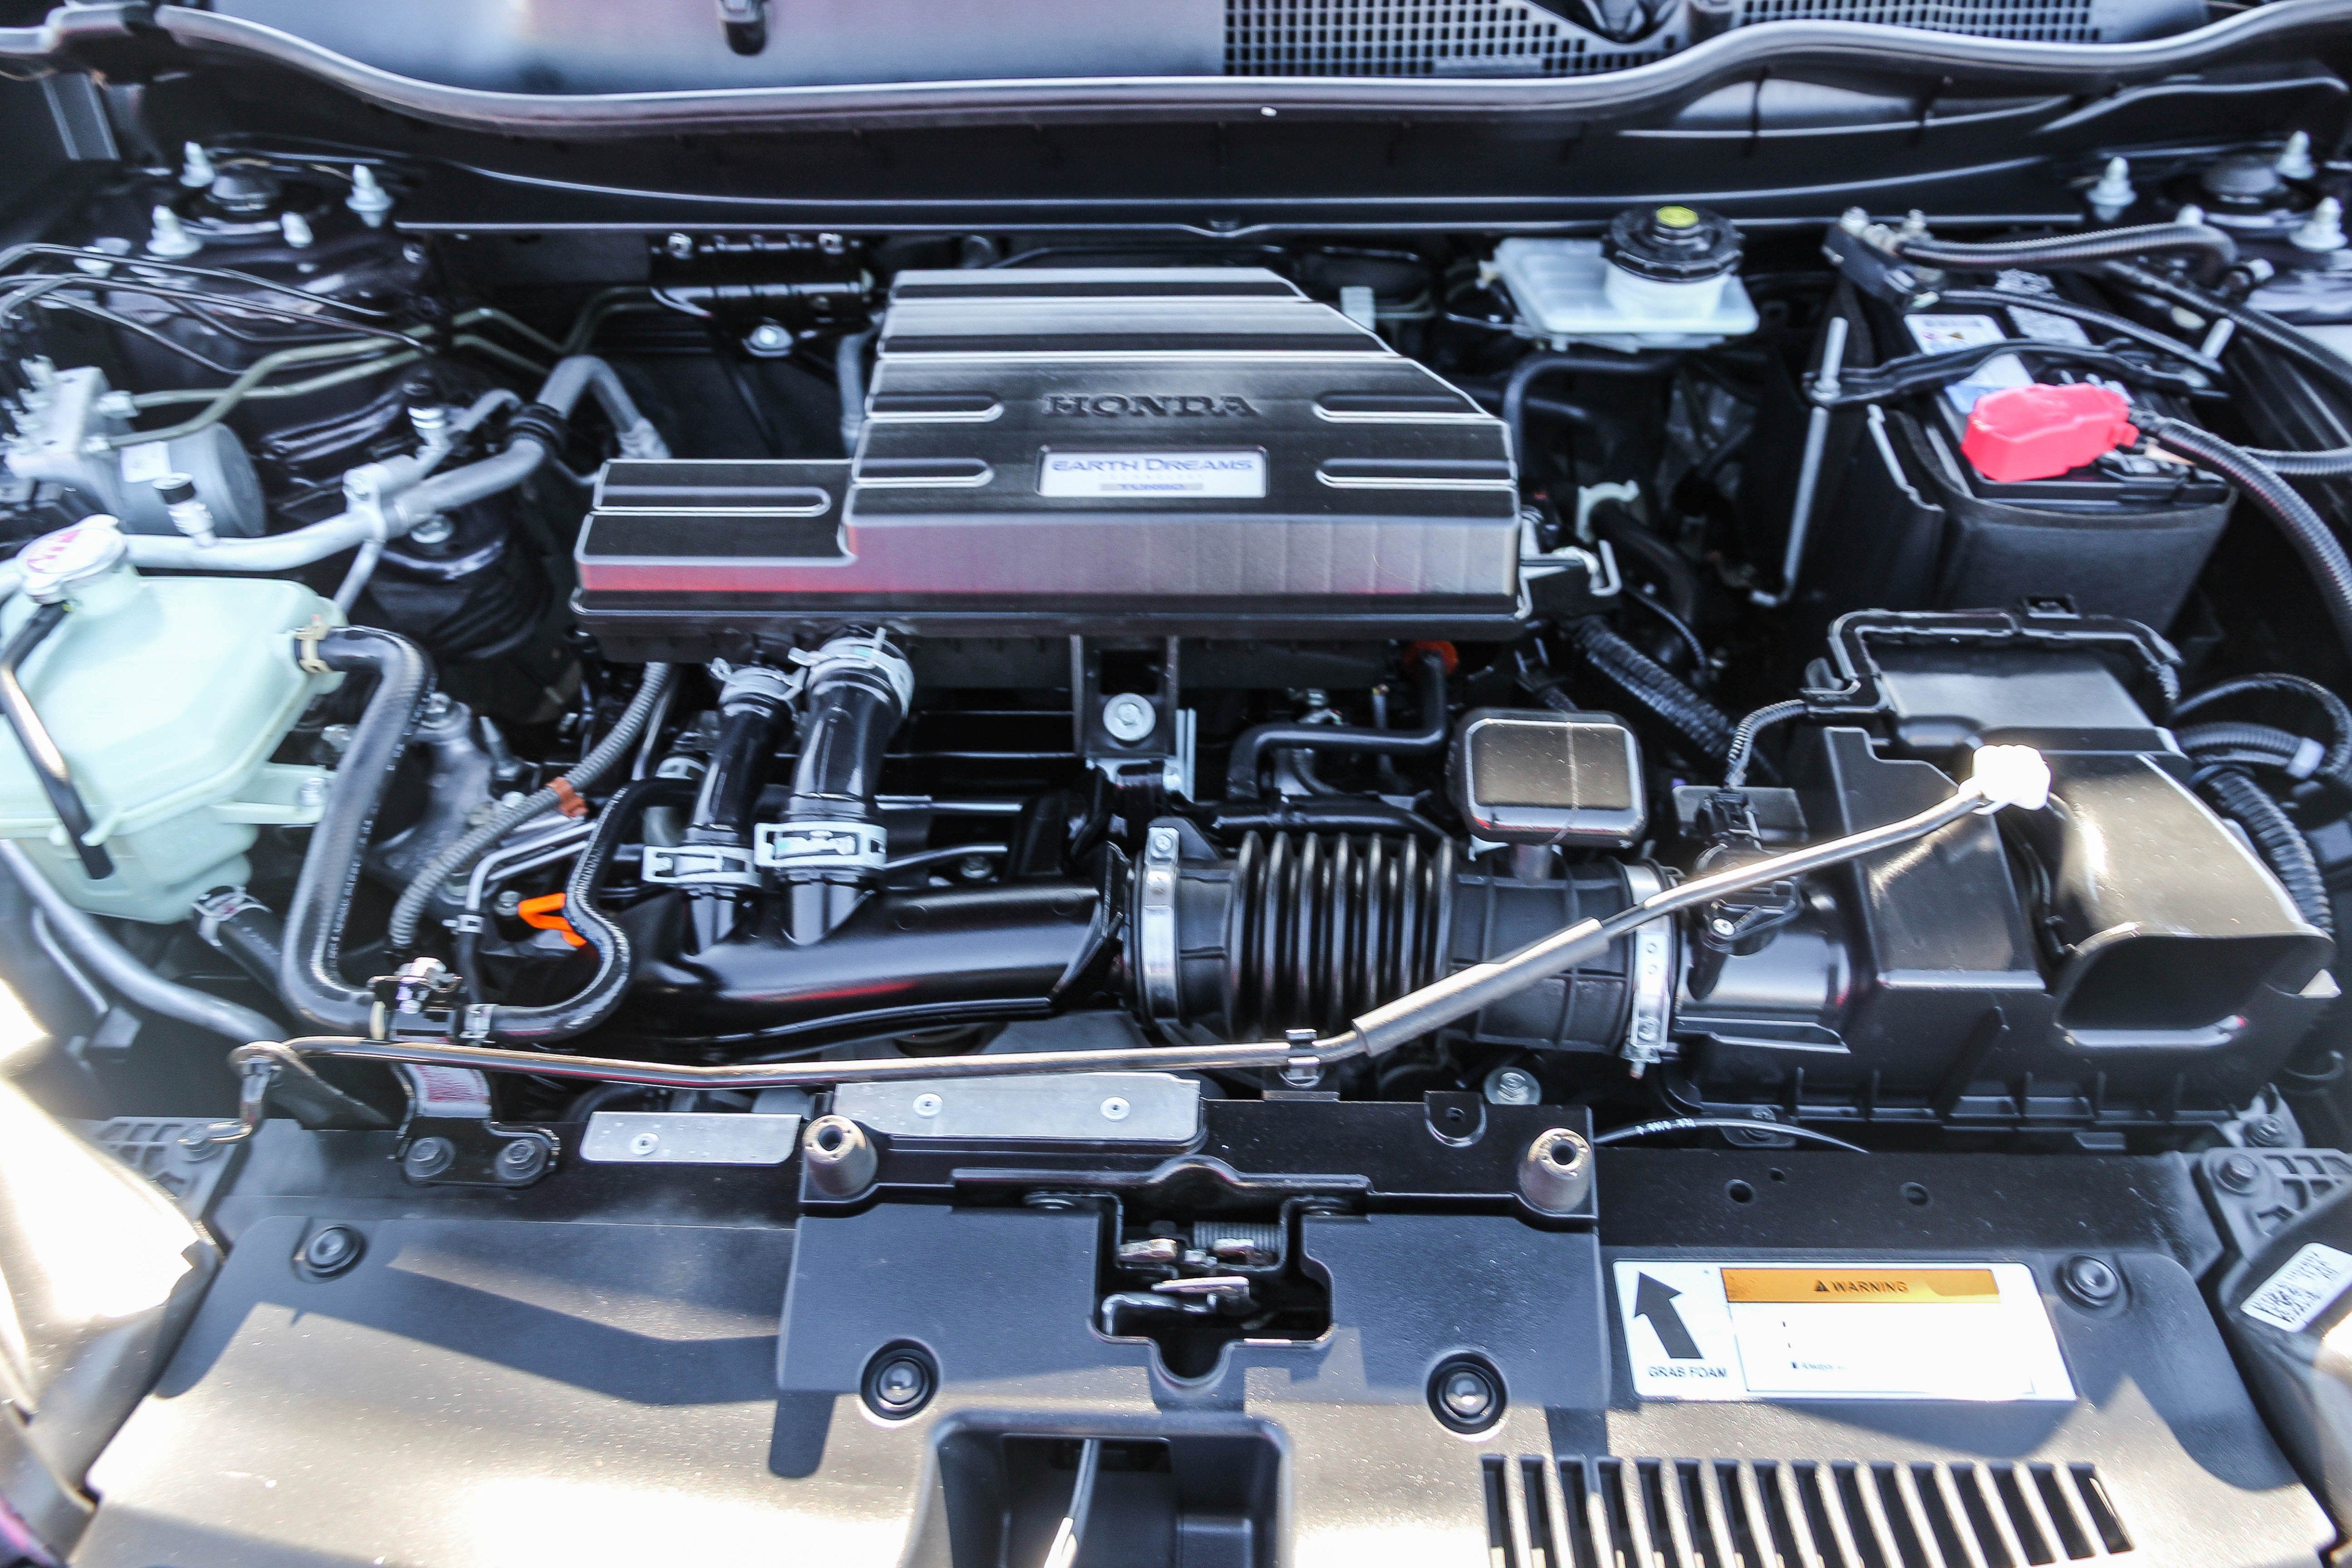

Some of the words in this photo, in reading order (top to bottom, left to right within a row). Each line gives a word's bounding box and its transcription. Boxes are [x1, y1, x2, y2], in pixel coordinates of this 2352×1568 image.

[1042, 393, 1263, 417] HONDA
[1052, 459, 1138, 471] EARTH
[1145, 457, 1252, 470] DREAMS
[1831, 1280, 1909, 1293] WARNING
[1648, 1366, 1686, 1378] GRAB
[1690, 1367, 1729, 1378] FOAM
